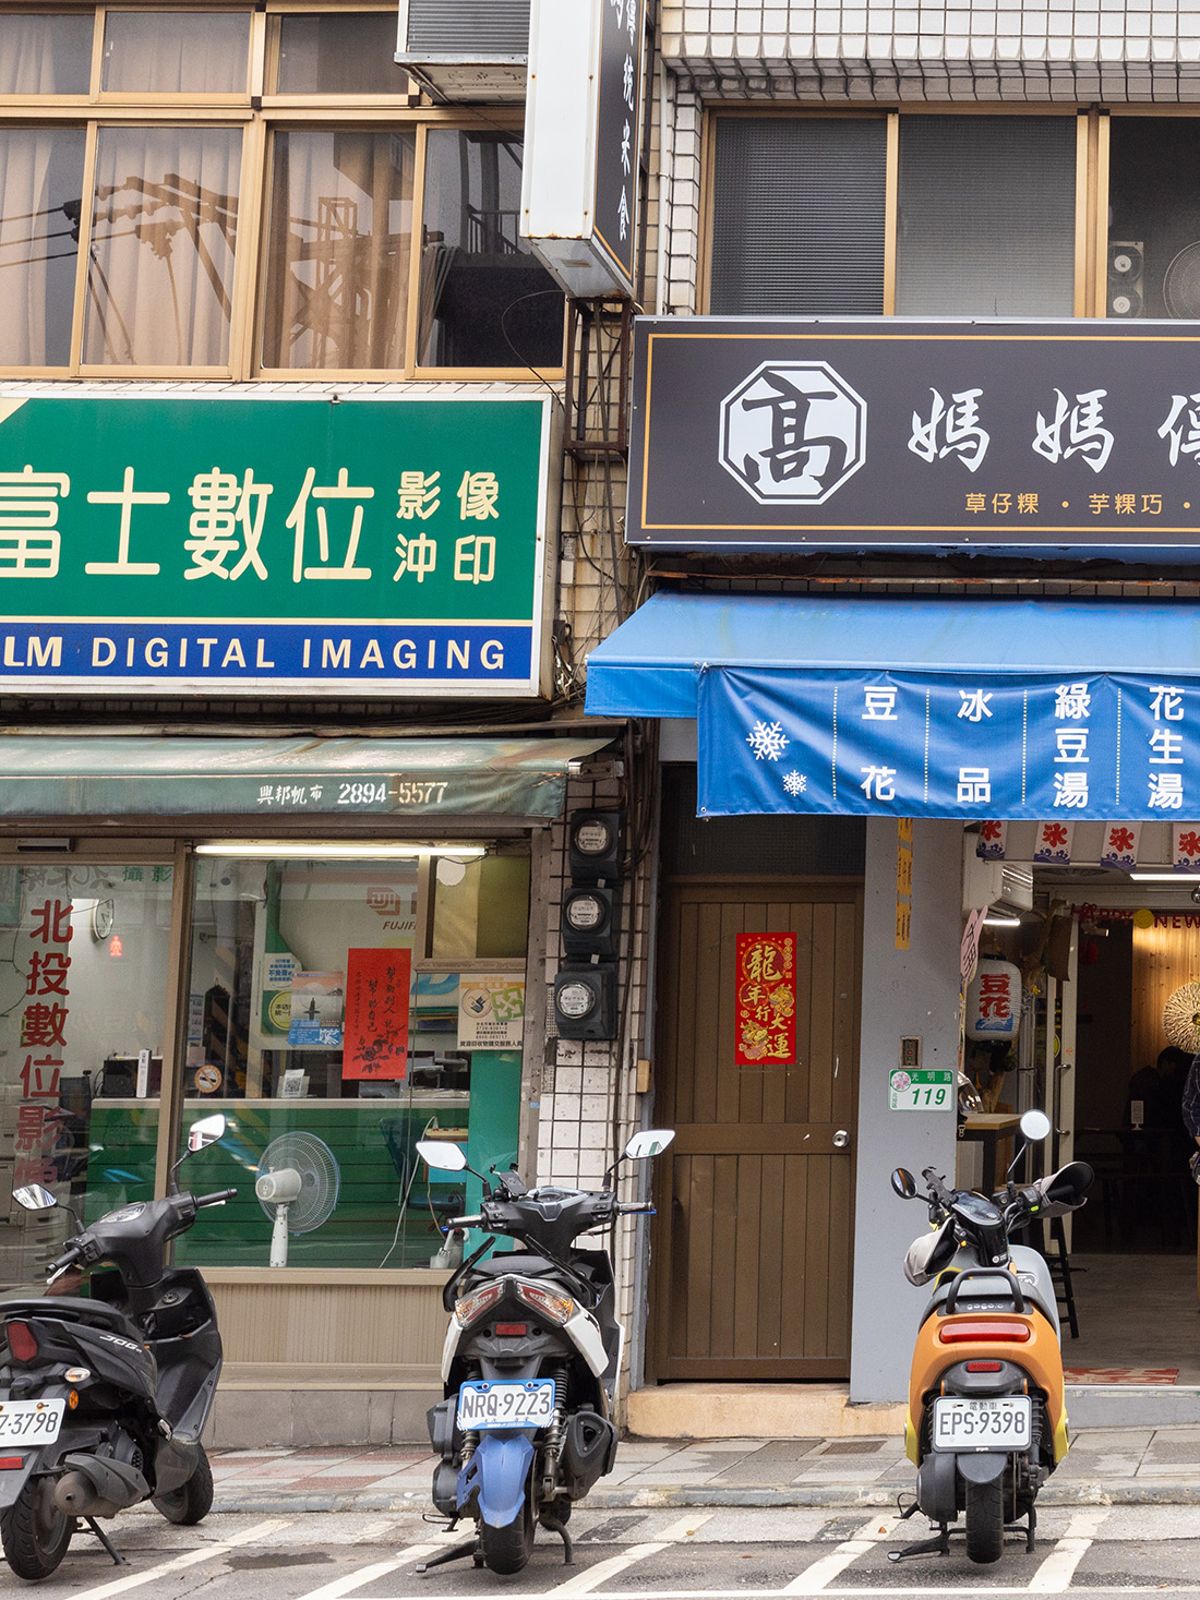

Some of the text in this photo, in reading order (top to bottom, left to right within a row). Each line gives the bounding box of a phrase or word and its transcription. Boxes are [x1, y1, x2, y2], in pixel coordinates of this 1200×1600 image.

[396, 470, 500, 521] 影像
[965, 493, 1039, 514] 草仔粿
[1088, 493, 1164, 515] 芋粿巧
[0, 465, 375, 583] 富士數位
[393, 533, 497, 584] 沖印
[3, 636, 505, 670] LM DIGITAL IMAGING
[860, 686, 898, 802] 豆花
[956, 689, 993, 803] 冰品
[1053, 683, 1091, 809] 綠豆湯
[1147, 685, 1186, 810] 花生湯
[337, 782, 449, 805] 2894-5577
[1154, 914, 1200, 928] NEW
[979, 973, 1010, 1018] 豆花
[912, 1088, 946, 1105] 119
